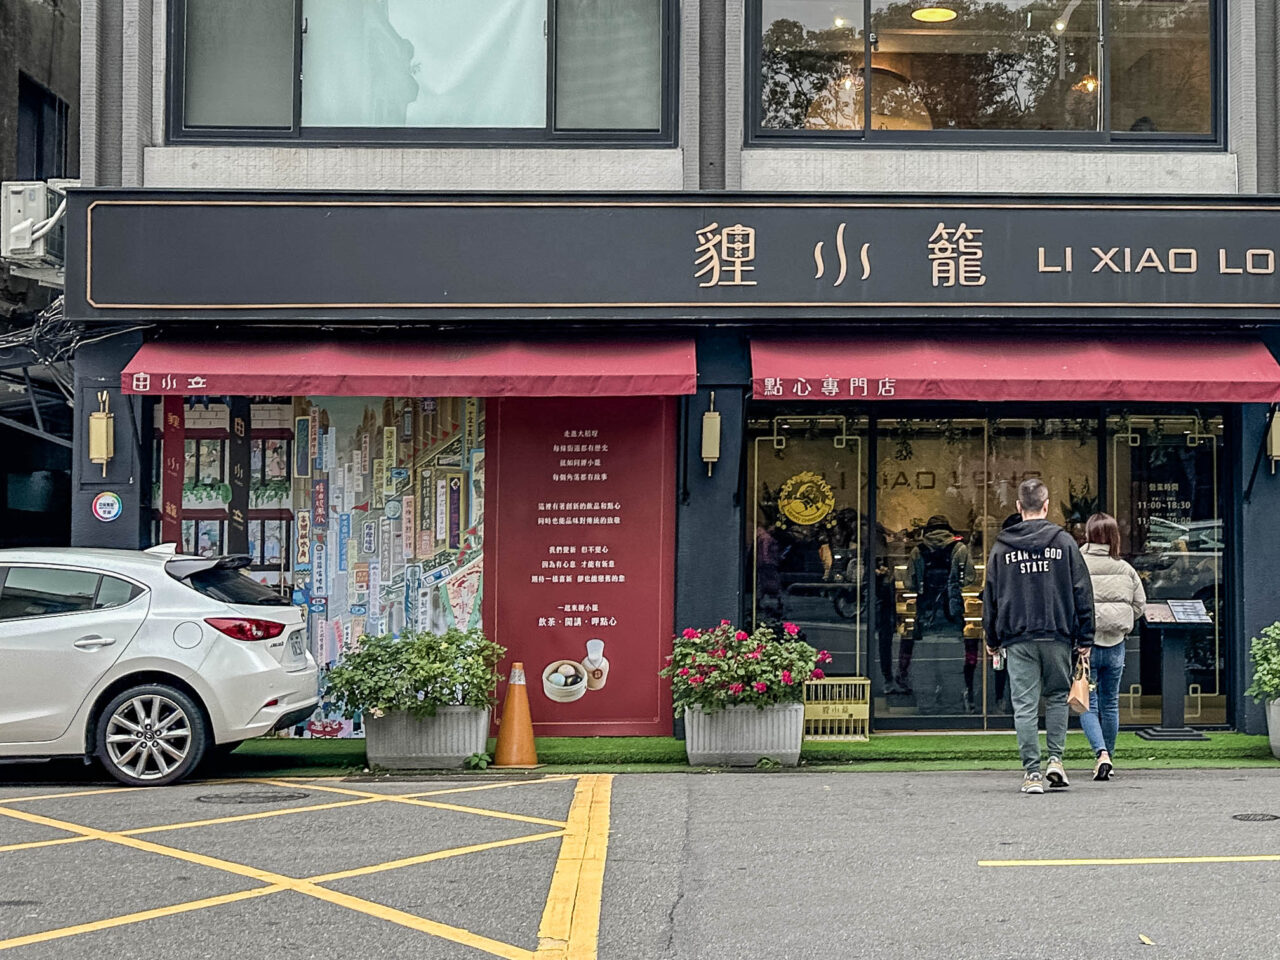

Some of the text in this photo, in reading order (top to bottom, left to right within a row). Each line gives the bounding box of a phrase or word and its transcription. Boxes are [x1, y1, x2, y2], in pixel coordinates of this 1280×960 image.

[1037, 247, 1073, 273] LI
[1091, 247, 1198, 273] XIAO
[764, 377, 896, 396] 點心專門店
[1044, 547, 1063, 560] GOD
[1020, 560, 1050, 574] STATE
